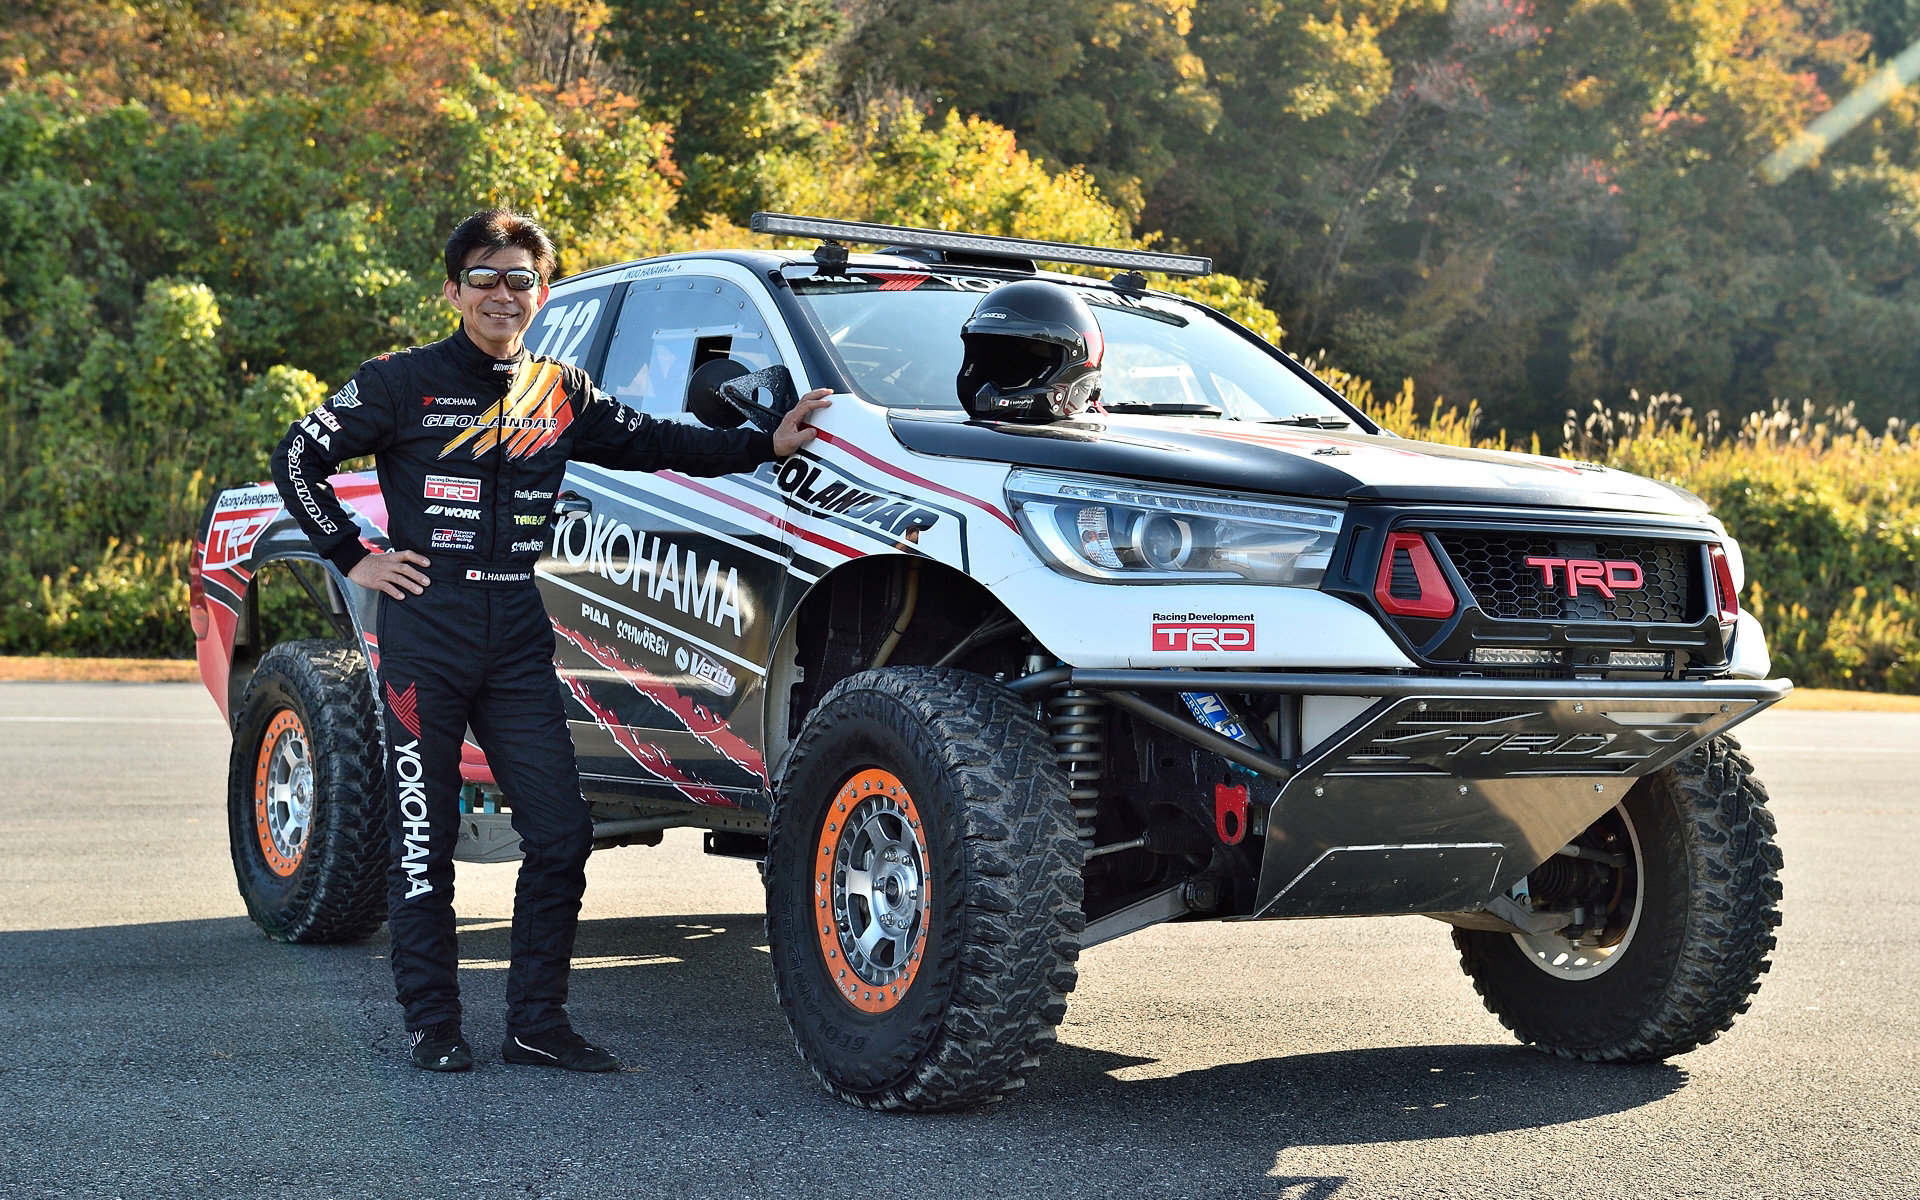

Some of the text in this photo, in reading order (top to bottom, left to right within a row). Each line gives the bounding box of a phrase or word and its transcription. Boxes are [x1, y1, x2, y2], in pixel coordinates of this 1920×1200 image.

[535, 298, 600, 366] 712
[435, 397, 477, 406] YOKOHAMA
[300, 416, 331, 451] IAA
[422, 414, 558, 430] GEOLANDAR
[218, 491, 284, 509] Racing Developmen
[428, 484, 477, 500] TRD
[752, 458, 940, 545] EOLANDAR
[444, 506, 482, 520] WORK
[213, 516, 268, 562] TRD
[431, 541, 475, 550] Indonesia
[551, 503, 742, 638] YOKOHAMA
[1524, 556, 1644, 599] TRD
[1152, 612, 1255, 623] Racing Development
[581, 602, 737, 693] PIAA SCHWÖREN Verity
[1156, 628, 1251, 651] TRD
[1444, 733, 1617, 755] TRD
[394, 739, 433, 899] YOKOHAMA
[781, 890, 867, 1053] GEOLANDAR
